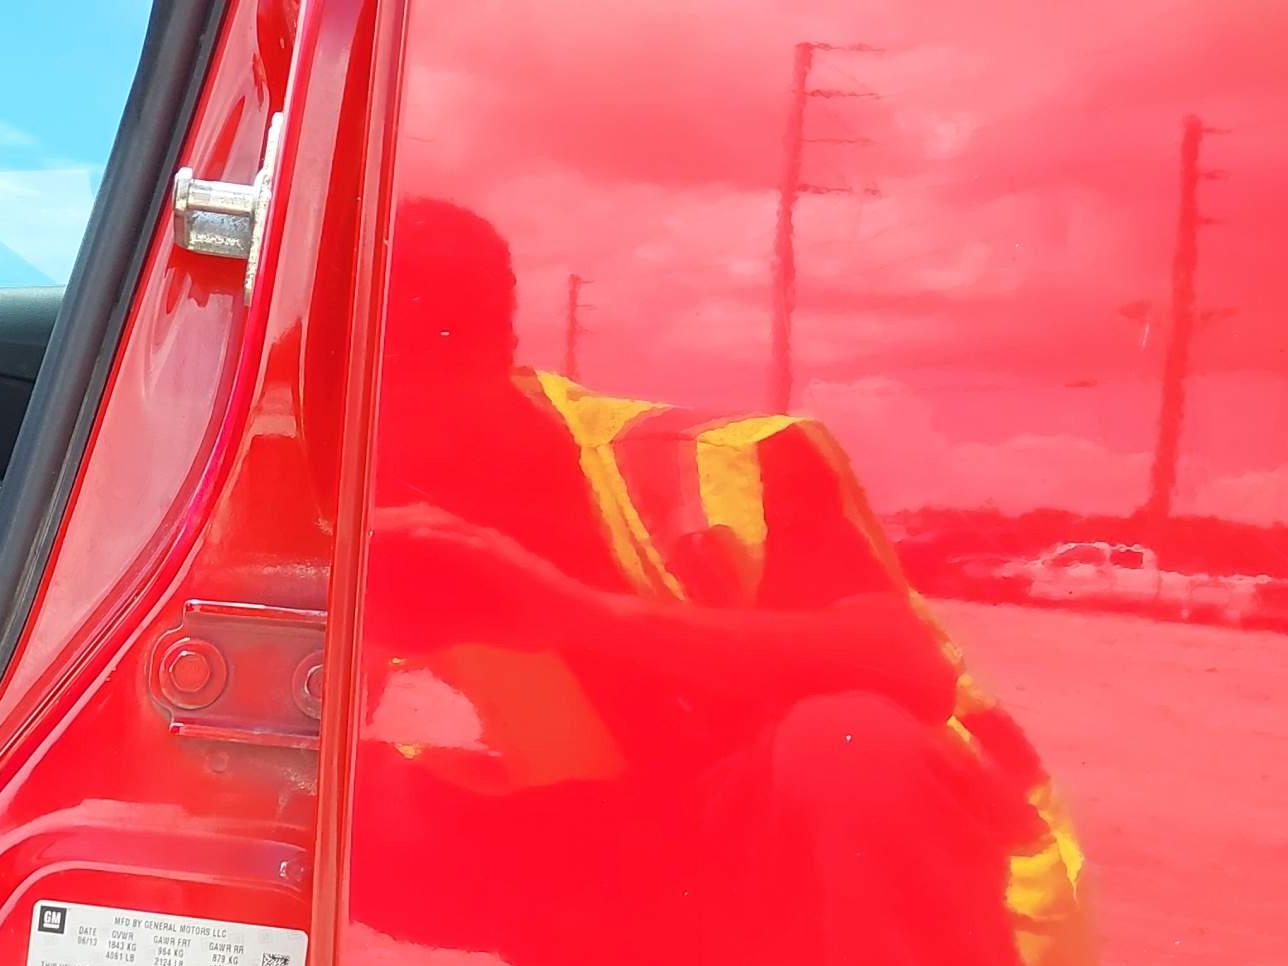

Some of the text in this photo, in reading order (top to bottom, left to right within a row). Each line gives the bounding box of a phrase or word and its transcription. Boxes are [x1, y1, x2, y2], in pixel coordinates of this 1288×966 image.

[43, 910, 61, 925] GM
[78, 926, 97, 936] DATE
[114, 917, 227, 938] MFD BY GENERAL MOTORS LLC
[112, 930, 133, 941] GVWR
[153, 935, 191, 948] GAWR FRT
[126, 943, 137, 952] KG
[208, 942, 244, 955] GAWR RR
[125, 953, 135, 962] LB
[174, 948, 184, 958] KG
[153, 957, 171, 966] 2124
[228, 956, 238, 965] KG
